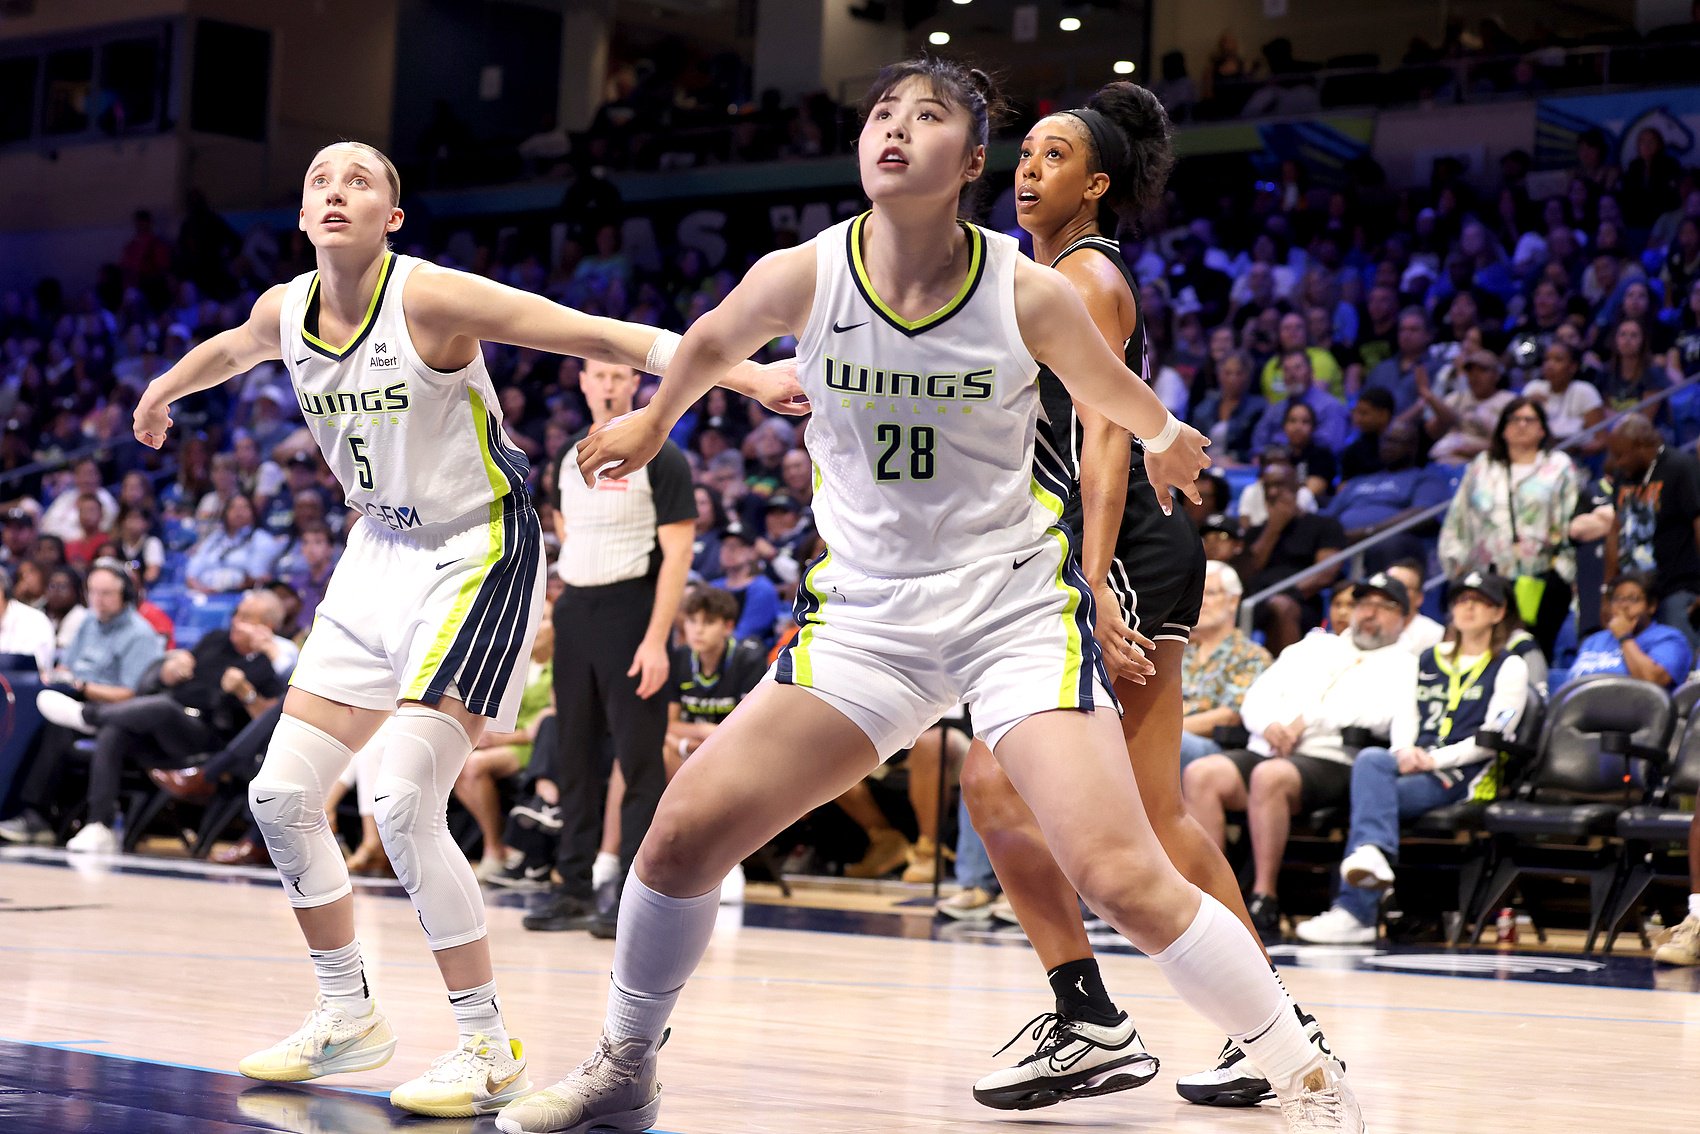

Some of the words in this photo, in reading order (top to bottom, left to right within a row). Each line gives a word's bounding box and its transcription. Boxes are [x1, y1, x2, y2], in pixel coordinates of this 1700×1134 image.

[369, 356, 397, 367] Albert
[824, 354, 995, 400] WINGS
[297, 380, 410, 418] WINGS
[841, 399, 972, 415] DALLAS
[346, 434, 375, 491] 5
[874, 423, 937, 483] 28
